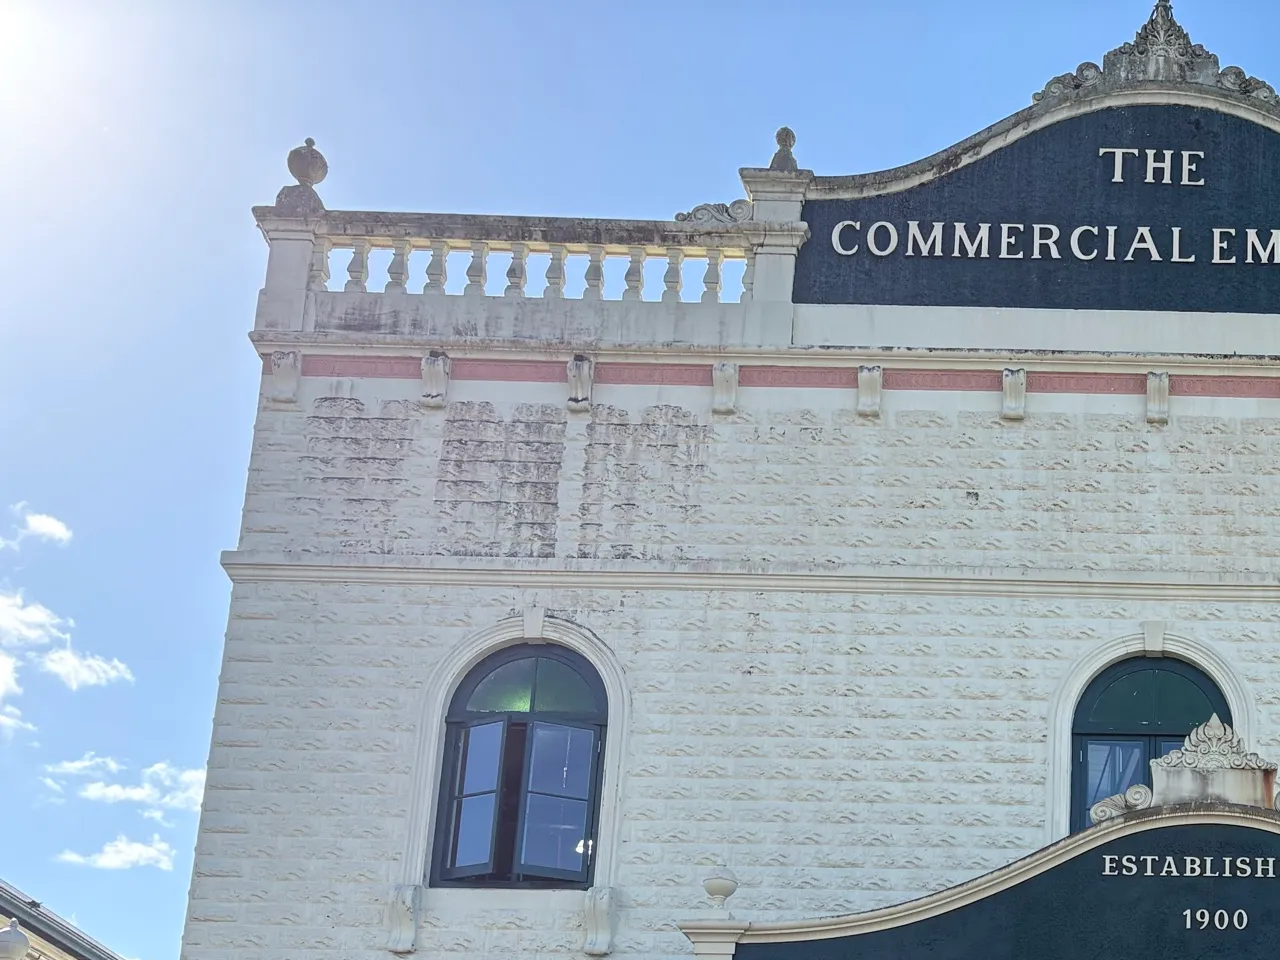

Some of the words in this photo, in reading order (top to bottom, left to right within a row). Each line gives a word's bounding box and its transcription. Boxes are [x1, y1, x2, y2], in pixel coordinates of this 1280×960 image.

[1099, 147, 1206, 187] THE
[830, 220, 1196, 264] COMMERCIAL
[1182, 908, 1249, 930] 1900
